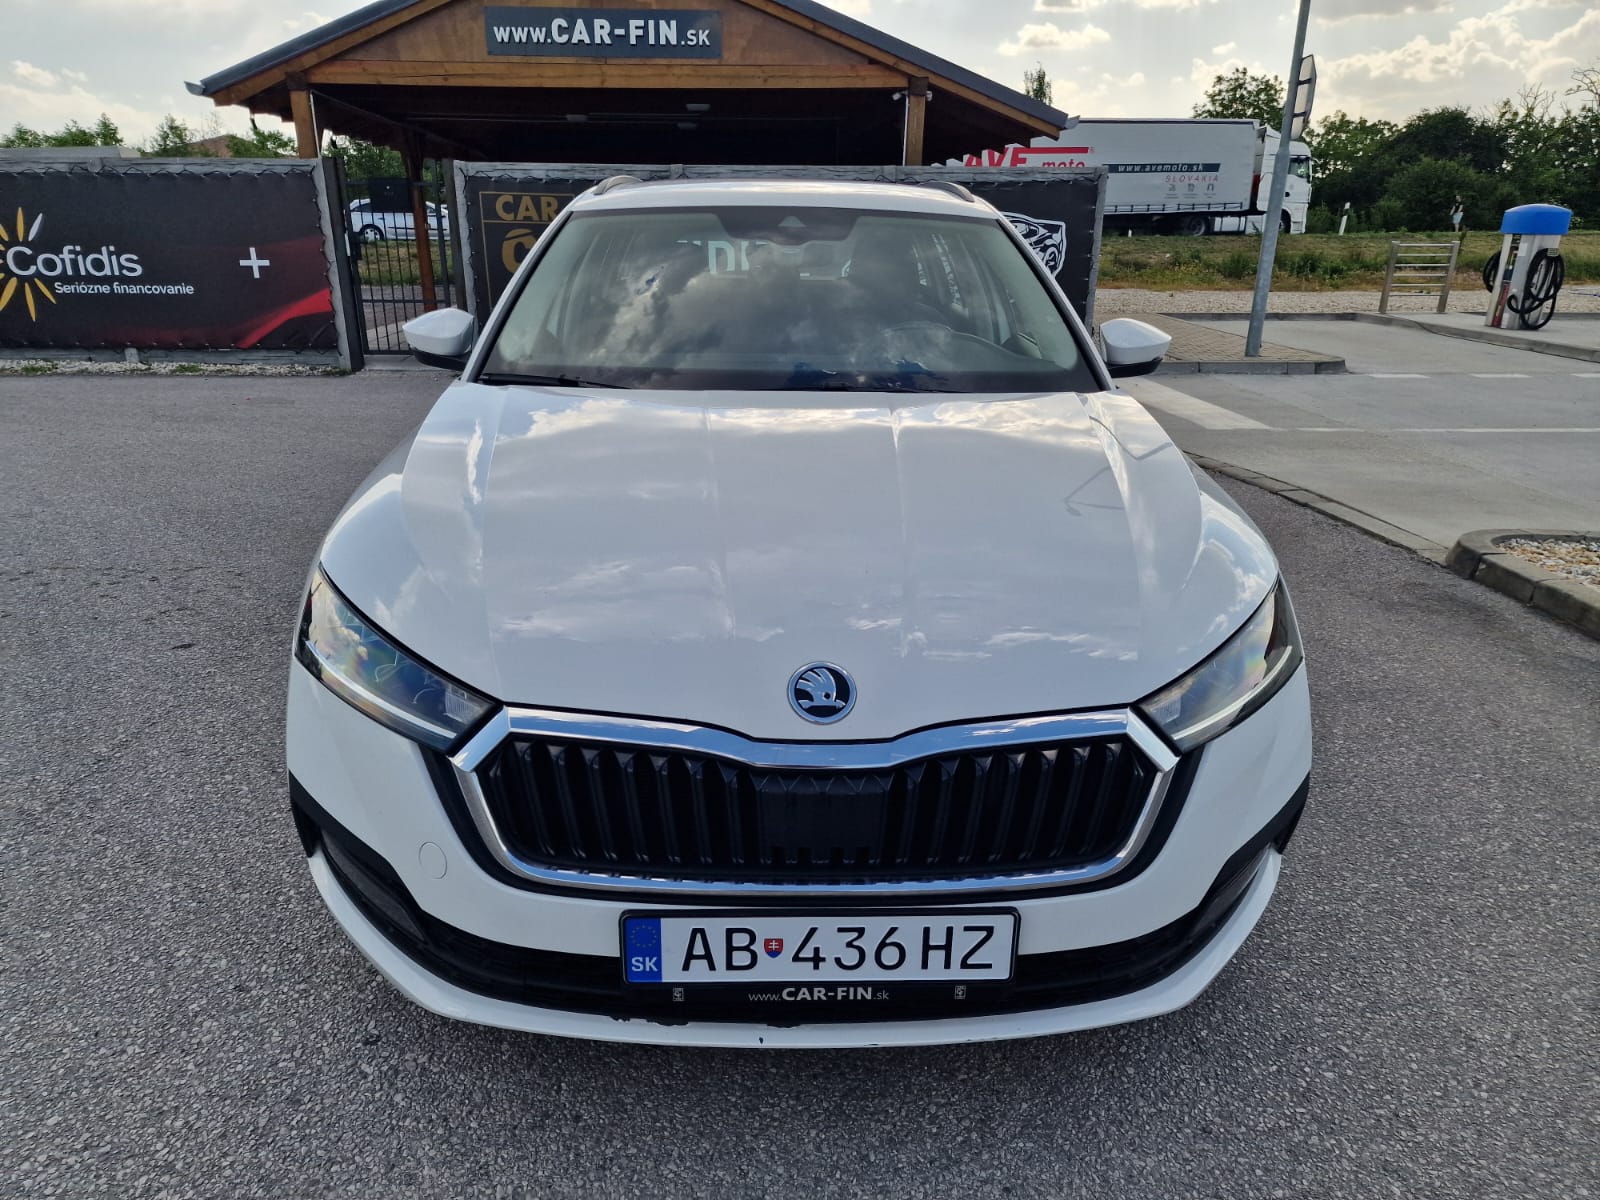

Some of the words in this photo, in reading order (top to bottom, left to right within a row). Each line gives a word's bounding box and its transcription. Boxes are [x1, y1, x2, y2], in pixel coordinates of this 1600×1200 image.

[1164, 174, 1219, 183] SLOVAKIA
[6, 245, 143, 277] Cofidis
[54, 282, 111, 294] Seriózne
[113, 282, 194, 295] financovanie
[631, 956, 658, 973] SK
[748, 986, 889, 1002] www.CAR-FIN.sk
